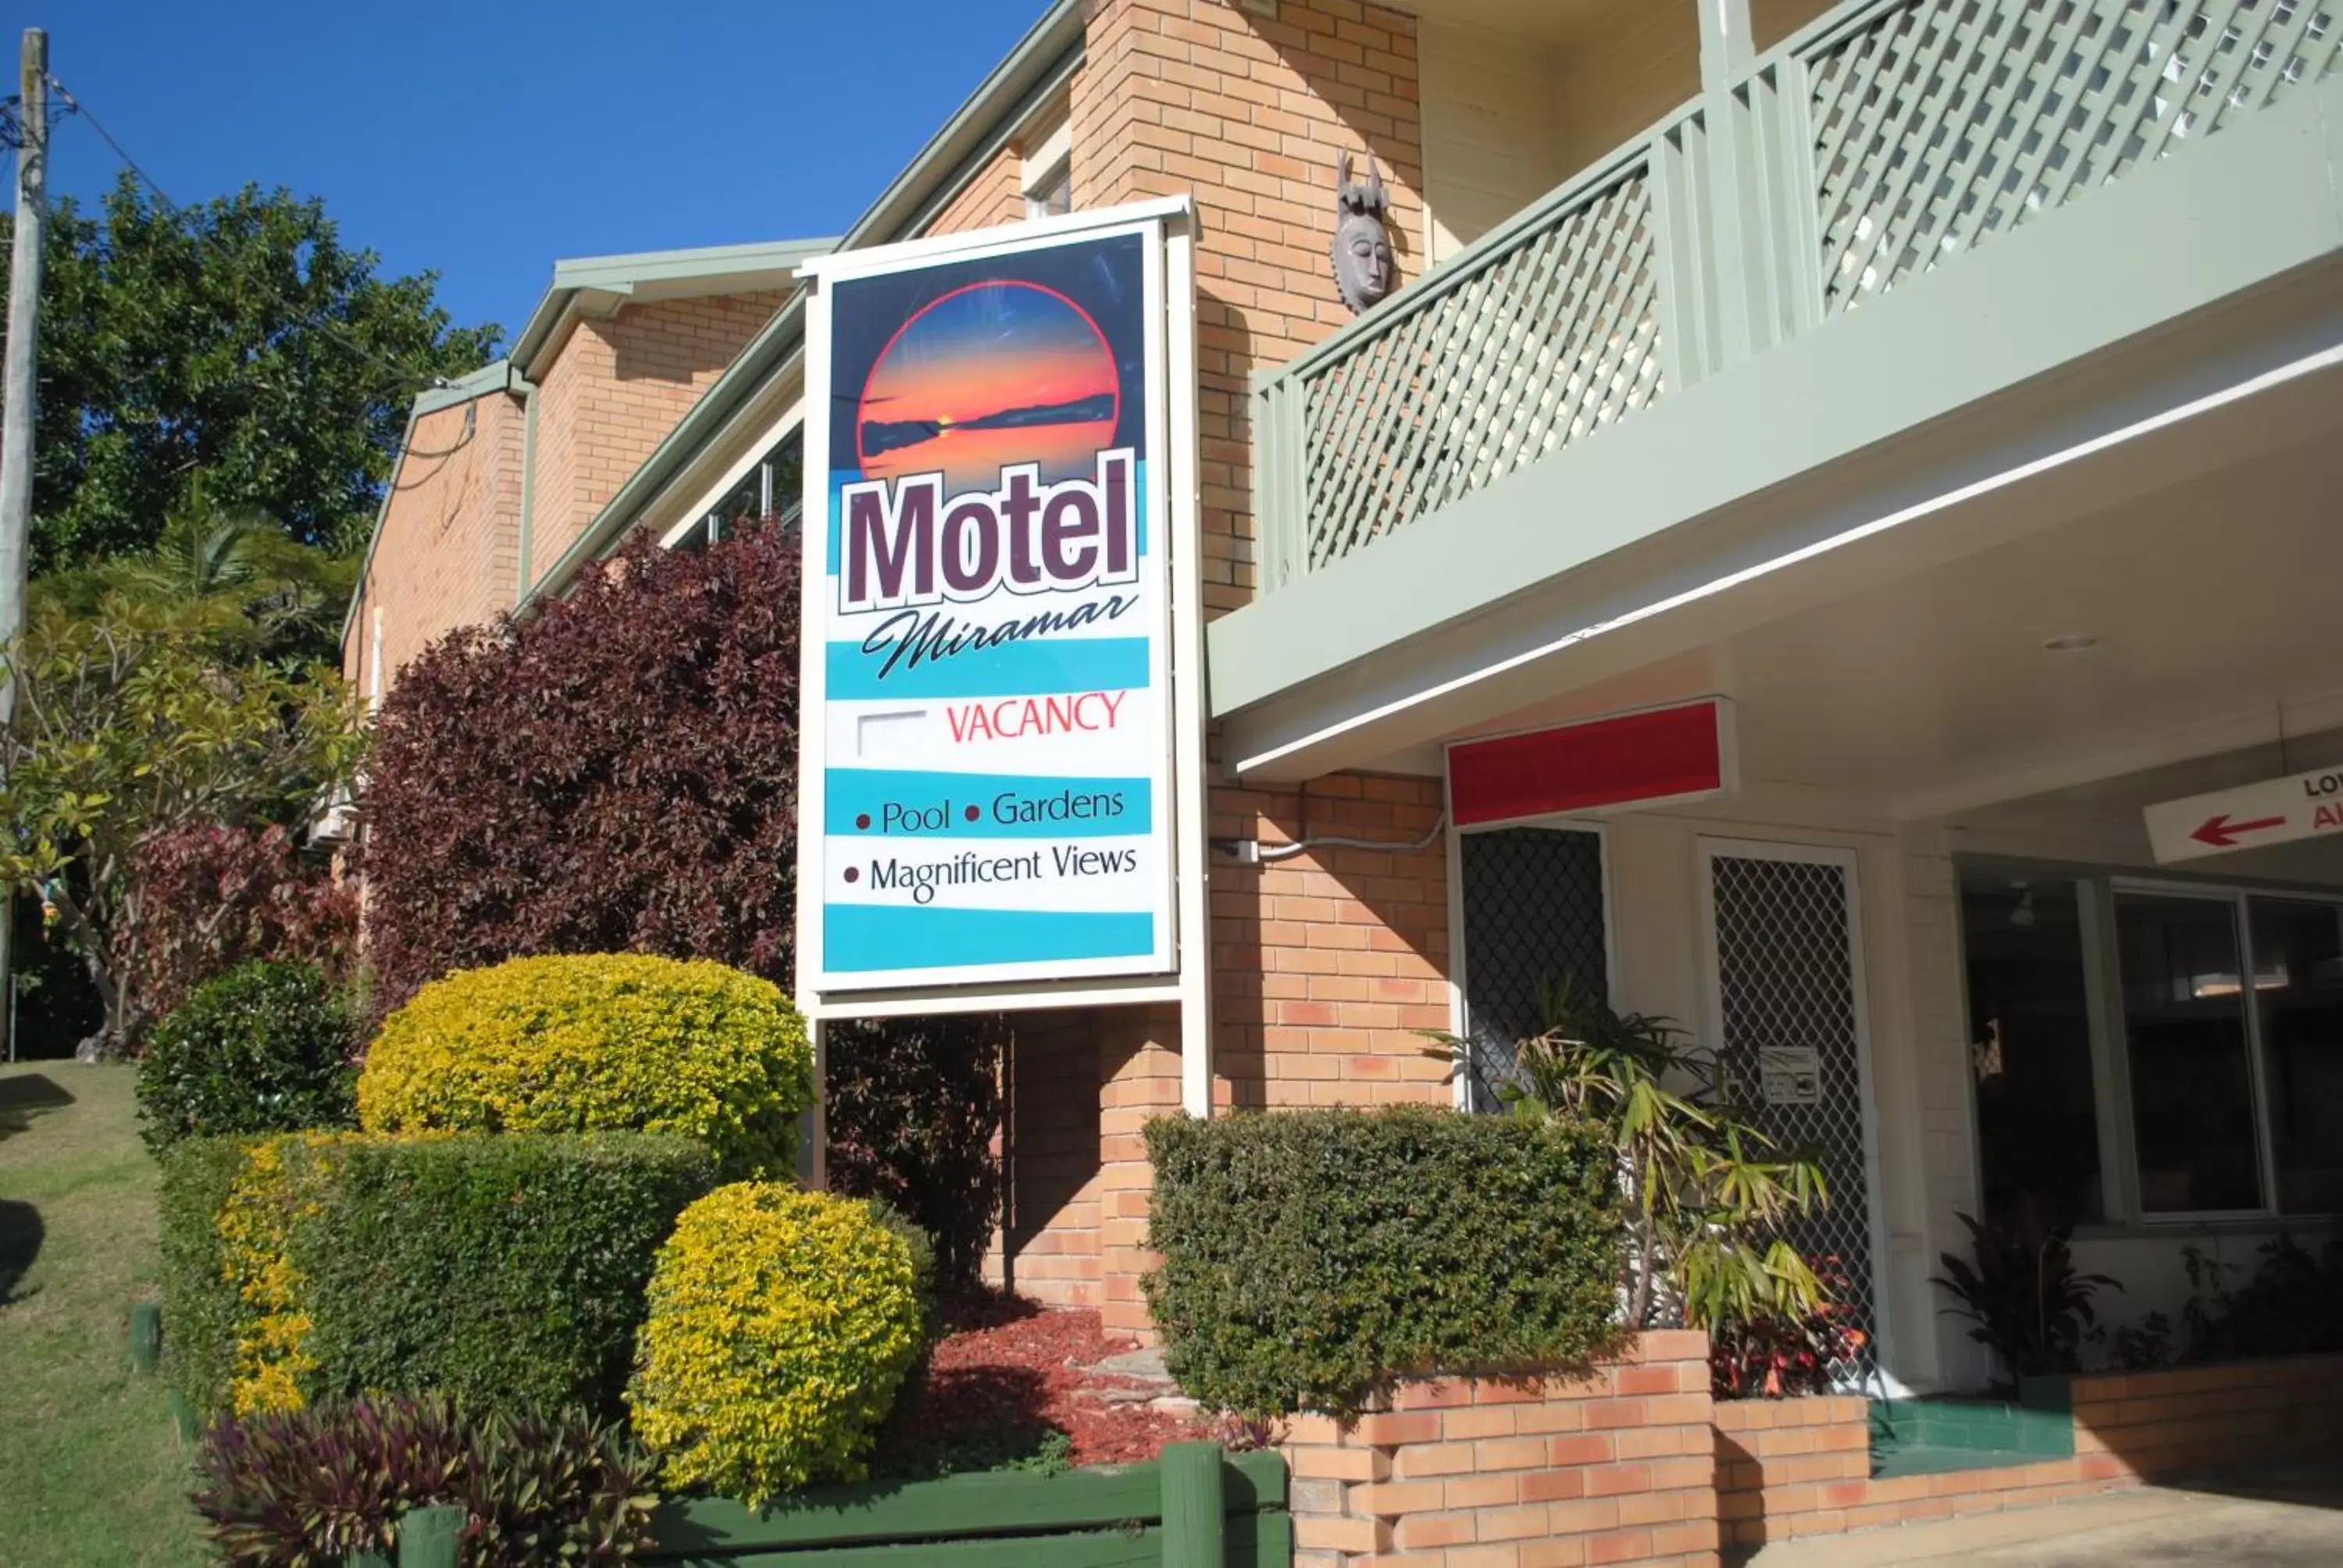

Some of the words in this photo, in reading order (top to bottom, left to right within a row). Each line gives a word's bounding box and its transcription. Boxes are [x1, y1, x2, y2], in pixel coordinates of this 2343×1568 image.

[847, 456, 1129, 604] Motel
[861, 594, 1139, 679] Miramar
[946, 690, 1126, 743] VACANCY
[883, 800, 950, 833] Pool
[993, 789, 1124, 825] Gardens
[870, 851, 1043, 904] Magnificent
[1051, 844, 1137, 876] Views
